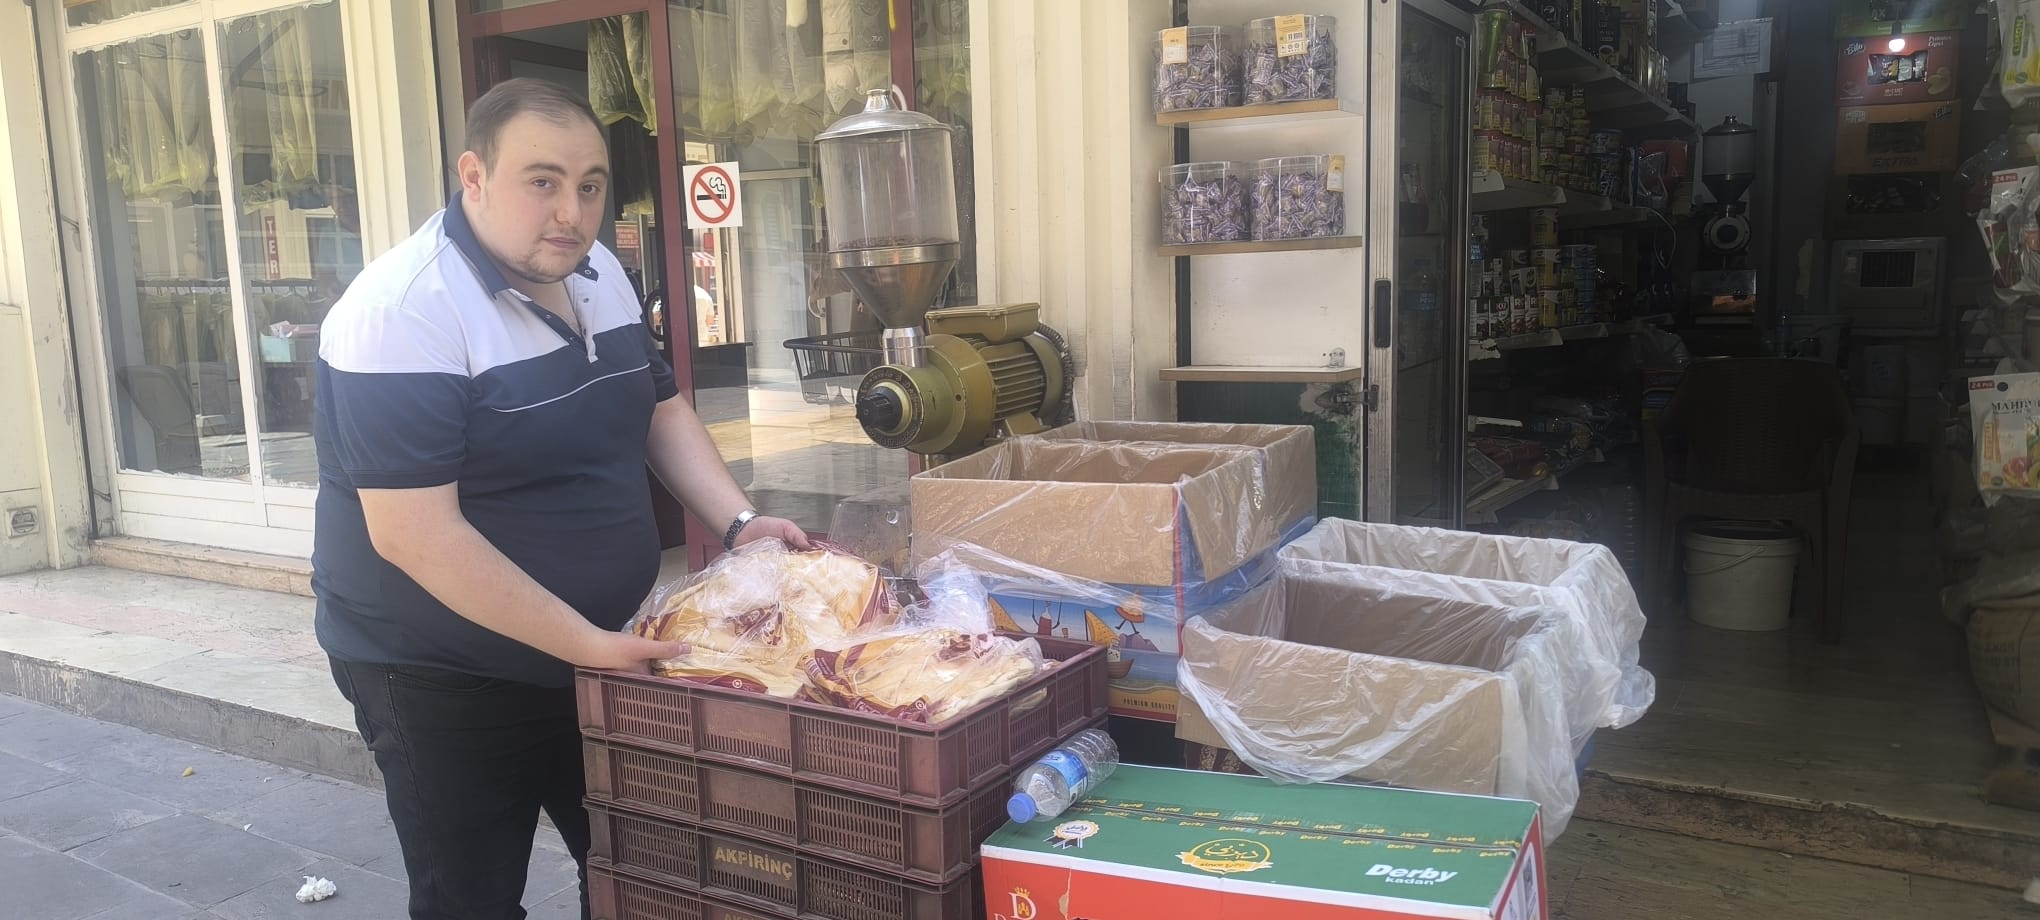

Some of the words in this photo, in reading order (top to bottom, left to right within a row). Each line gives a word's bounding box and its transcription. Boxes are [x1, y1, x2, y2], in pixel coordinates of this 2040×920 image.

[1123, 697, 1149, 707] PREMIUM
[1151, 701, 1175, 711] QUALITY
[715, 847, 793, 880] AKPİRİNÇ
[1365, 864, 1458, 882] Derby
[1386, 876, 1434, 885] kadan
